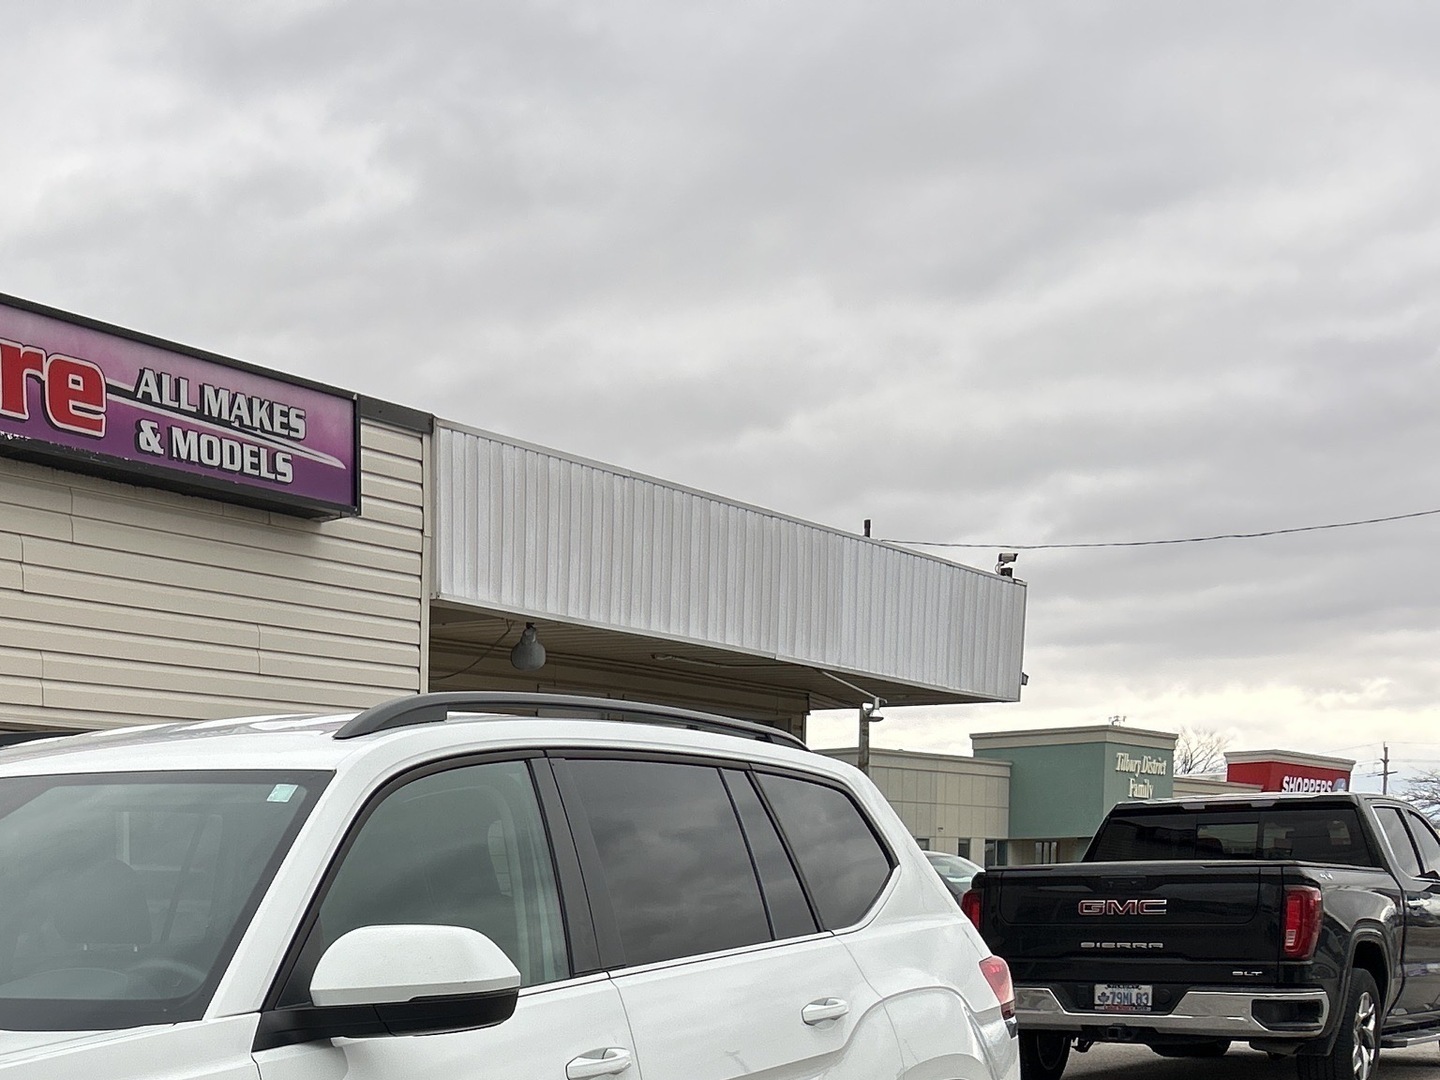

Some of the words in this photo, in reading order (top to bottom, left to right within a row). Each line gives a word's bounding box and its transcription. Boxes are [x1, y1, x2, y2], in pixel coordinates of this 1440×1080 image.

[136, 367, 197, 412] ALL
[200, 383, 306, 439] MAKES
[137, 419, 164, 455] &
[169, 425, 293, 484] MODELS
[1115, 752, 1141, 777] Tilbury
[1140, 755, 1167, 775] District
[1128, 777, 1154, 800] Family
[1282, 776, 1332, 793] SHOPPERS
[1078, 899, 1167, 915] GMC
